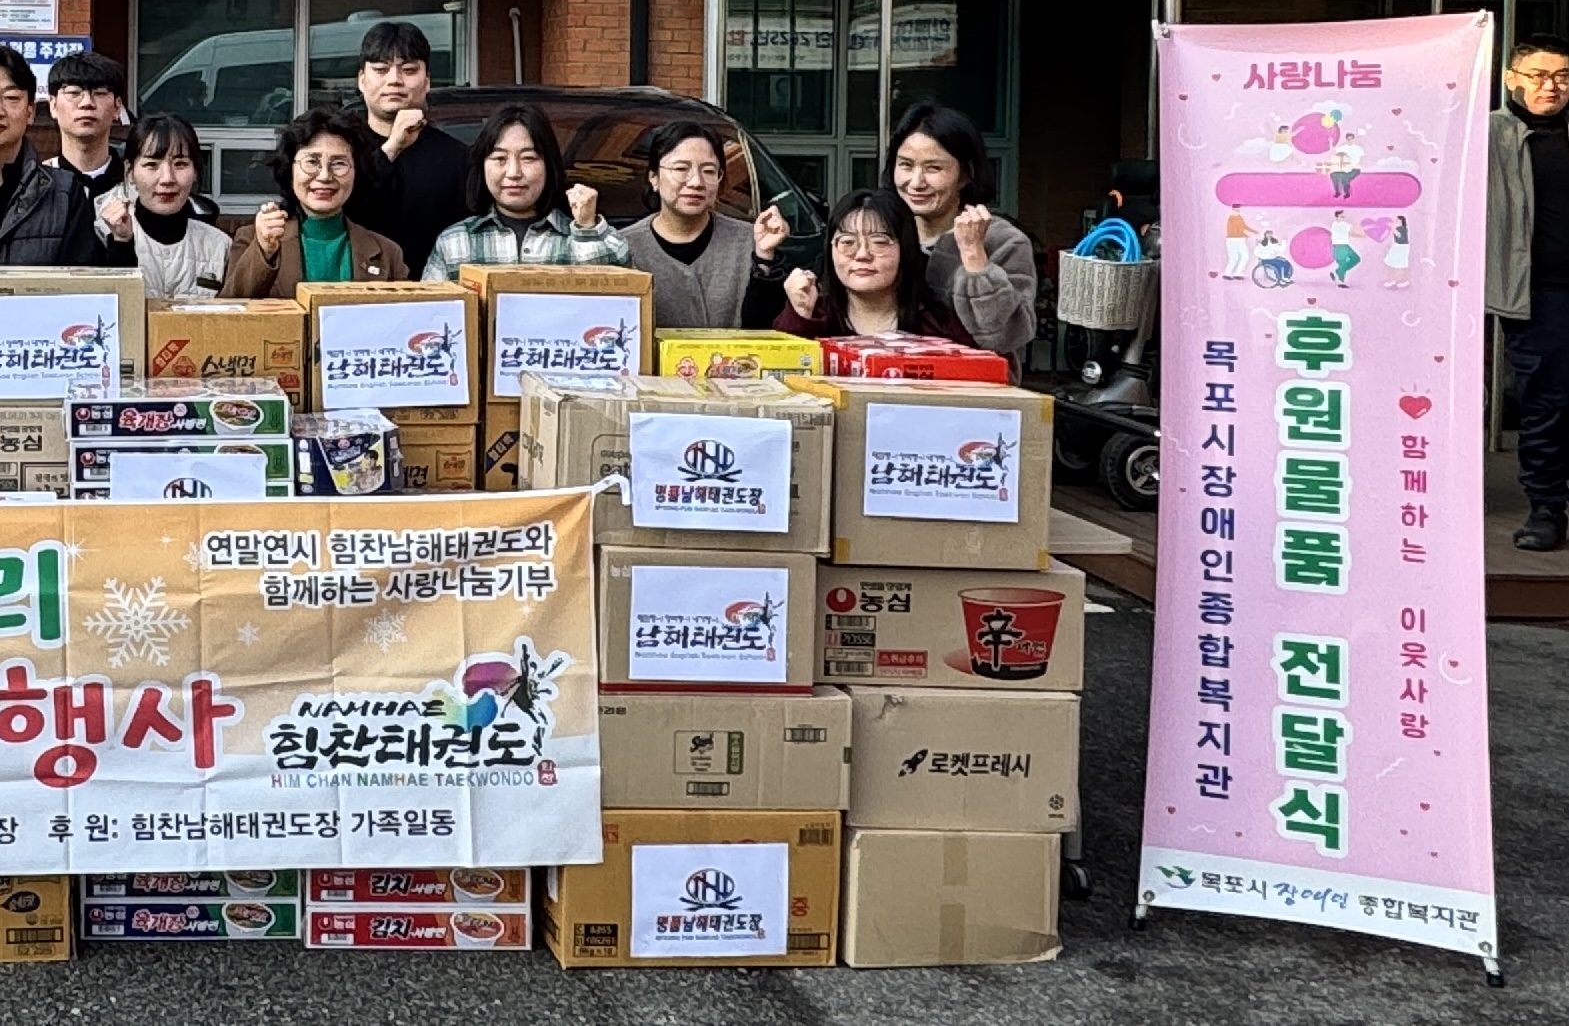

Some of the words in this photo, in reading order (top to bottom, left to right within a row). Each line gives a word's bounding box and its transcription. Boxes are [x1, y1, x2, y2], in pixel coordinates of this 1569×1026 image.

[1242, 59, 1384, 92] 사랑나눔
[200, 355, 257, 378] 스낵면
[327, 356, 449, 380] 남해태권도
[500, 347, 621, 370] 남해태권도
[119, 408, 174, 431] 육개장
[0, 434, 43, 453] 농심
[1280, 315, 1346, 588] 후원물품
[871, 462, 999, 490] 남해태권도
[655, 484, 763, 506] 명품남해태권도장
[1399, 433, 1430, 564] 함께하는
[206, 533, 318, 566] 연말연시
[331, 524, 553, 565] 힘찬남해태권도와
[1195, 340, 1238, 800] 목포시장애인종합복지관
[264, 575, 376, 606] 함께하는
[385, 566, 554, 601] 사랑나눔기부
[859, 592, 912, 613] 농심
[635, 625, 767, 650] 남해태권도
[977, 608, 1025, 671] 辛
[1399, 606, 1431, 741] 이웃사랑
[298, 700, 446, 716] NAMHAE
[270, 722, 535, 770] 힘찬태권도
[1280, 639, 1346, 853] 전달식
[928, 752, 1031, 778] 로켓프레시
[271, 773, 301, 788] HIM
[306, 773, 351, 788] CHAN
[357, 772, 430, 787] NAMHAE
[436, 772, 533, 787] TAEKWONDO
[47, 815, 74, 843] 후
[84, 814, 119, 842] 원:
[131, 809, 342, 842] 힘찬남해태권도장
[350, 808, 456, 838] 가족일동
[370, 874, 413, 895] 김치
[1201, 871, 1267, 899] 목포시
[1358, 894, 1479, 931] 종합복지관
[370, 917, 413, 939] 김치
[656, 913, 763, 933] 명품남해태권도장
